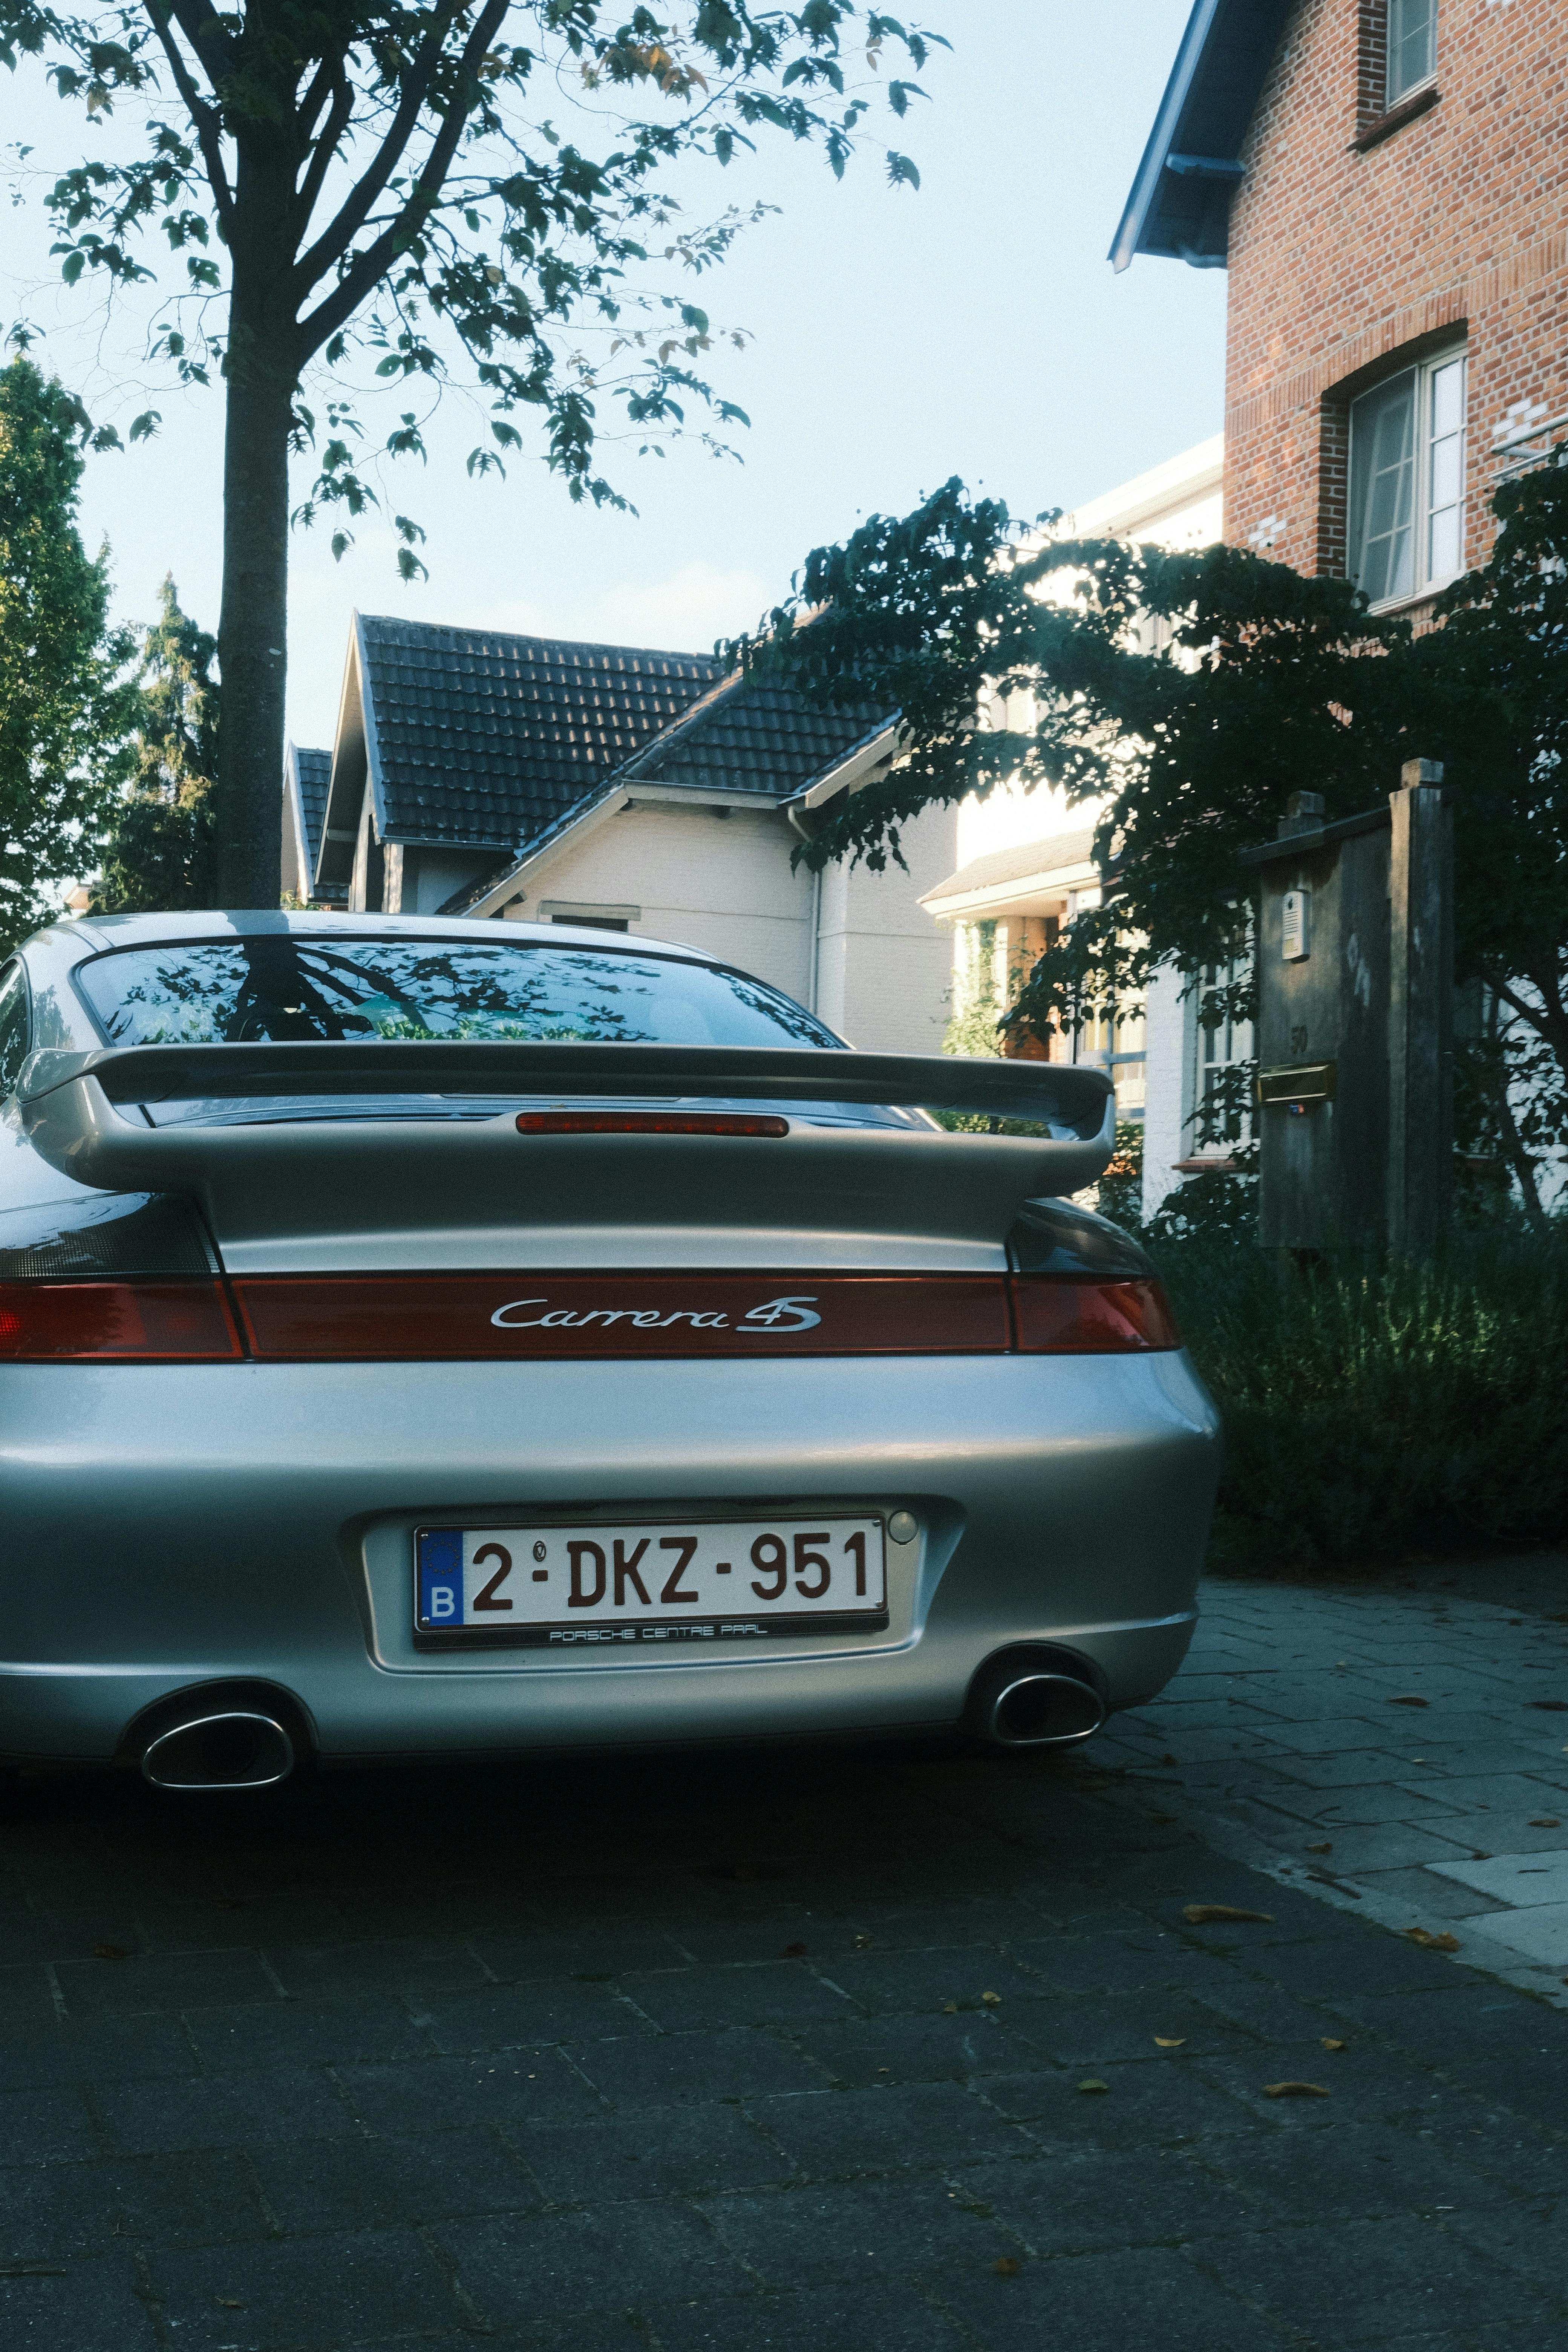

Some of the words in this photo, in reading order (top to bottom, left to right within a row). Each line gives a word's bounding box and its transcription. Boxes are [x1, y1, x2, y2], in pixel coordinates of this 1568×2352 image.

[490, 1298, 730, 1328] Carrera
[735, 1296, 822, 1332] 4S
[431, 1586, 455, 1617] B
[550, 1629, 636, 1642] PORSCHE
[642, 1626, 715, 1638] CENTRE
[721, 1624, 768, 1635] PAAL
